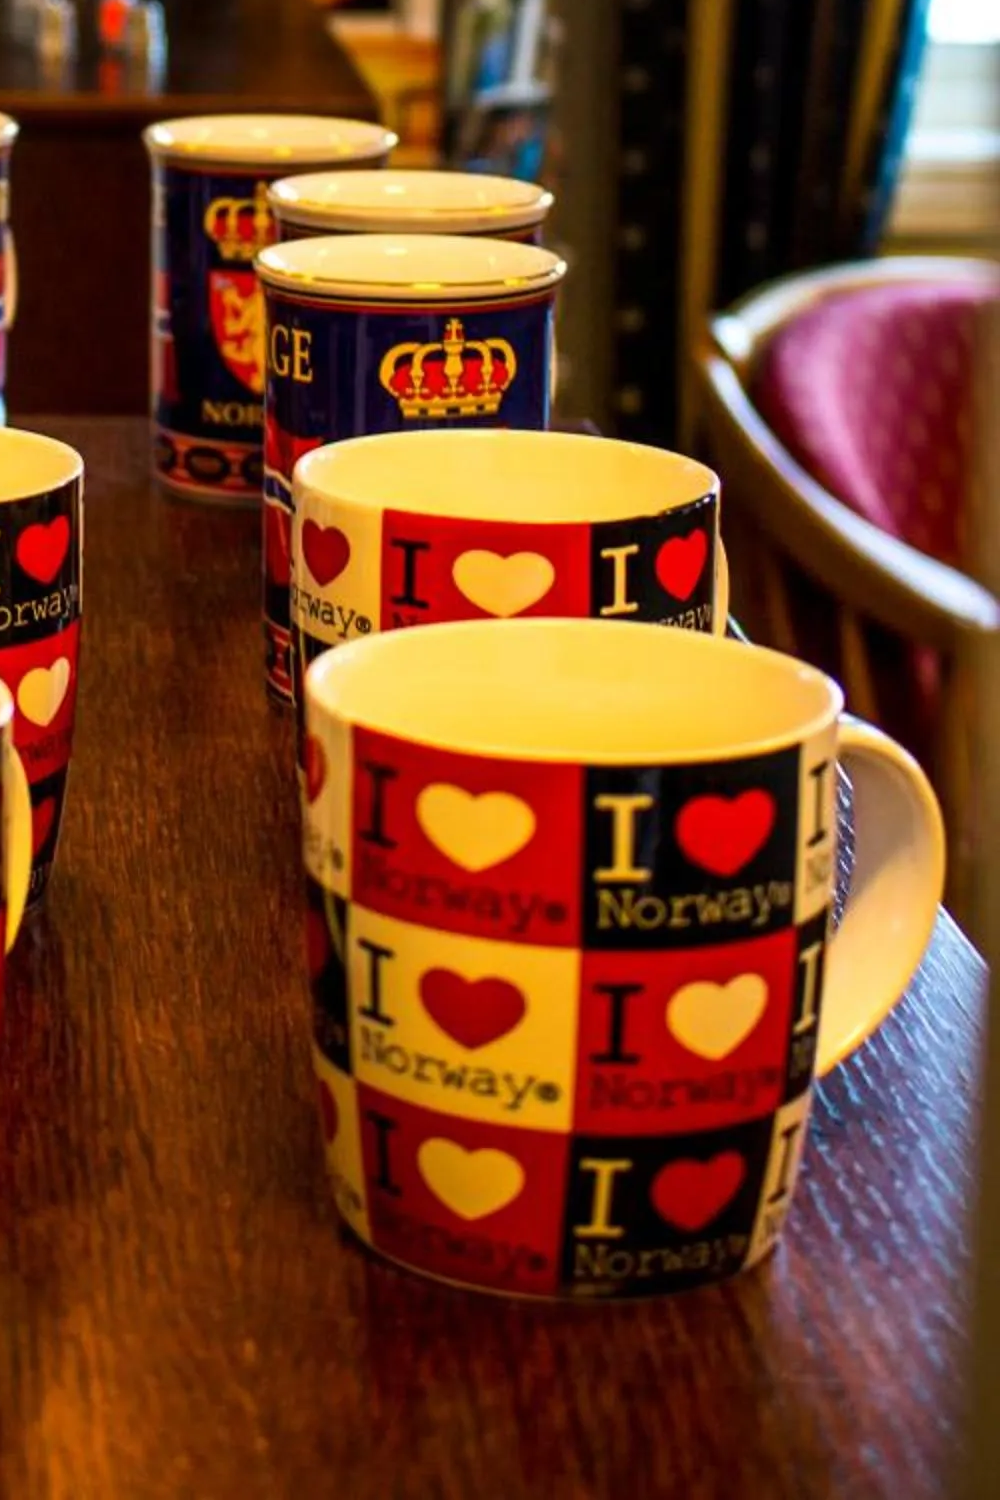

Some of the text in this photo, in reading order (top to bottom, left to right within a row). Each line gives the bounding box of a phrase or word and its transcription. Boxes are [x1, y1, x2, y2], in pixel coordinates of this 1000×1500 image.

[391, 537, 431, 609] I
[601, 543, 640, 616] I
[362, 761, 399, 849] I
[592, 791, 656, 884] I
[357, 936, 396, 1027] I
[590, 982, 644, 1064] I
[571, 1156, 635, 1240] I
